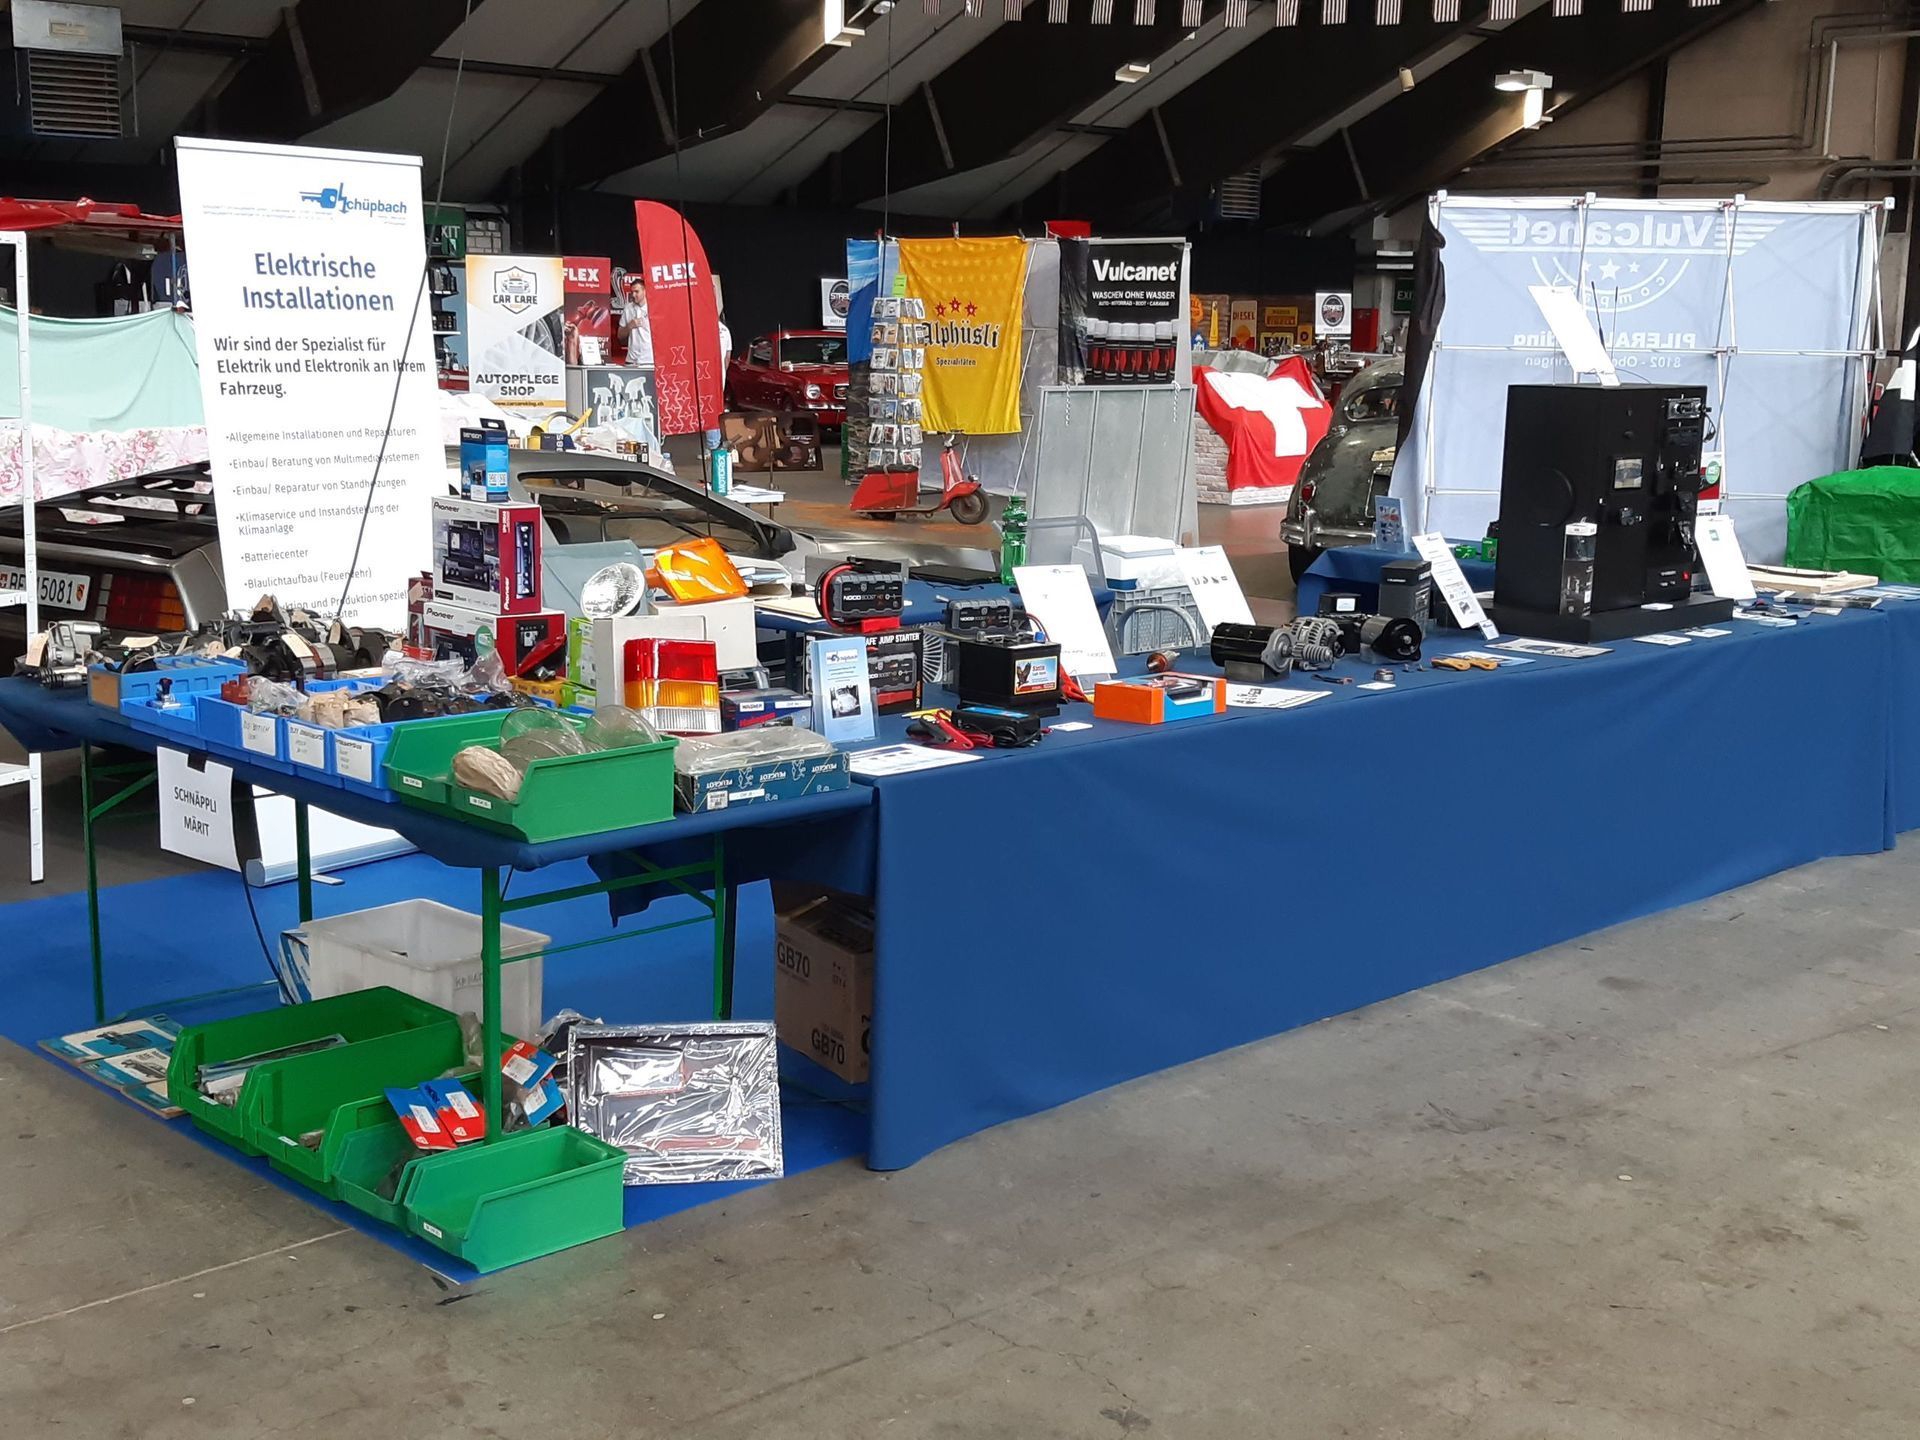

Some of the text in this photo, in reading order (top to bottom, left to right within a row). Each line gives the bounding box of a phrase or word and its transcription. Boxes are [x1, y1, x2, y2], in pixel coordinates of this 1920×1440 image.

[441, 225, 460, 238] XIT
[255, 252, 376, 279] Elektrische
[651, 262, 697, 283] FLEX
[1092, 259, 1177, 281] Vulcanet
[562, 268, 599, 282] FLEX
[243, 286, 394, 312] Installationen
[493, 295, 538, 304] CAR CARE
[1092, 291, 1175, 299] WASCHEN OHNE WASSER
[1397, 291, 1412, 300] EXI
[1233, 311, 1255, 320] DIESEL
[921, 320, 1000, 348] Alphüsli
[214, 336, 386, 354] Wir sind der Spezialist für
[217, 359, 426, 374] Elektrik und Elektronik an Ihrem
[476, 374, 559, 384] AUTOPFLEGE
[220, 382, 287, 398] Fahrzeug.
[500, 386, 536, 396] SHOP
[229, 432, 280, 444] Allgemeine
[282, 430, 344, 440] Installationen
[346, 429, 362, 438] und
[272, 456, 313, 468] Beratung
[316, 456, 332, 465] von
[275, 482, 320, 494] Reparatur
[322, 482, 338, 491] von
[240, 510, 296, 522] Klimaservice
[299, 508, 316, 518] und
[386, 504, 399, 512] der
[434, 502, 460, 512] Pioneer
[238, 524, 294, 536] Klimaanlage
[244, 550, 308, 562] Batteriecenter
[248, 572, 318, 589] Blaulichtaufbau
[311, 600, 328, 609] und
[330, 594, 377, 606] Prduktion
[426, 608, 454, 621] Pioneer
[866, 632, 920, 646] AFE JUMP STARTER
[812, 763, 838, 772] PEUGEOT
[760, 771, 786, 781] PEUGEOT
[706, 779, 733, 788] PEUGEOT
[174, 786, 216, 813] SCHNÄPPLI
[184, 816, 210, 837] MÄRIT
[777, 942, 810, 978] GB70
[811, 1028, 845, 1065] GB70
